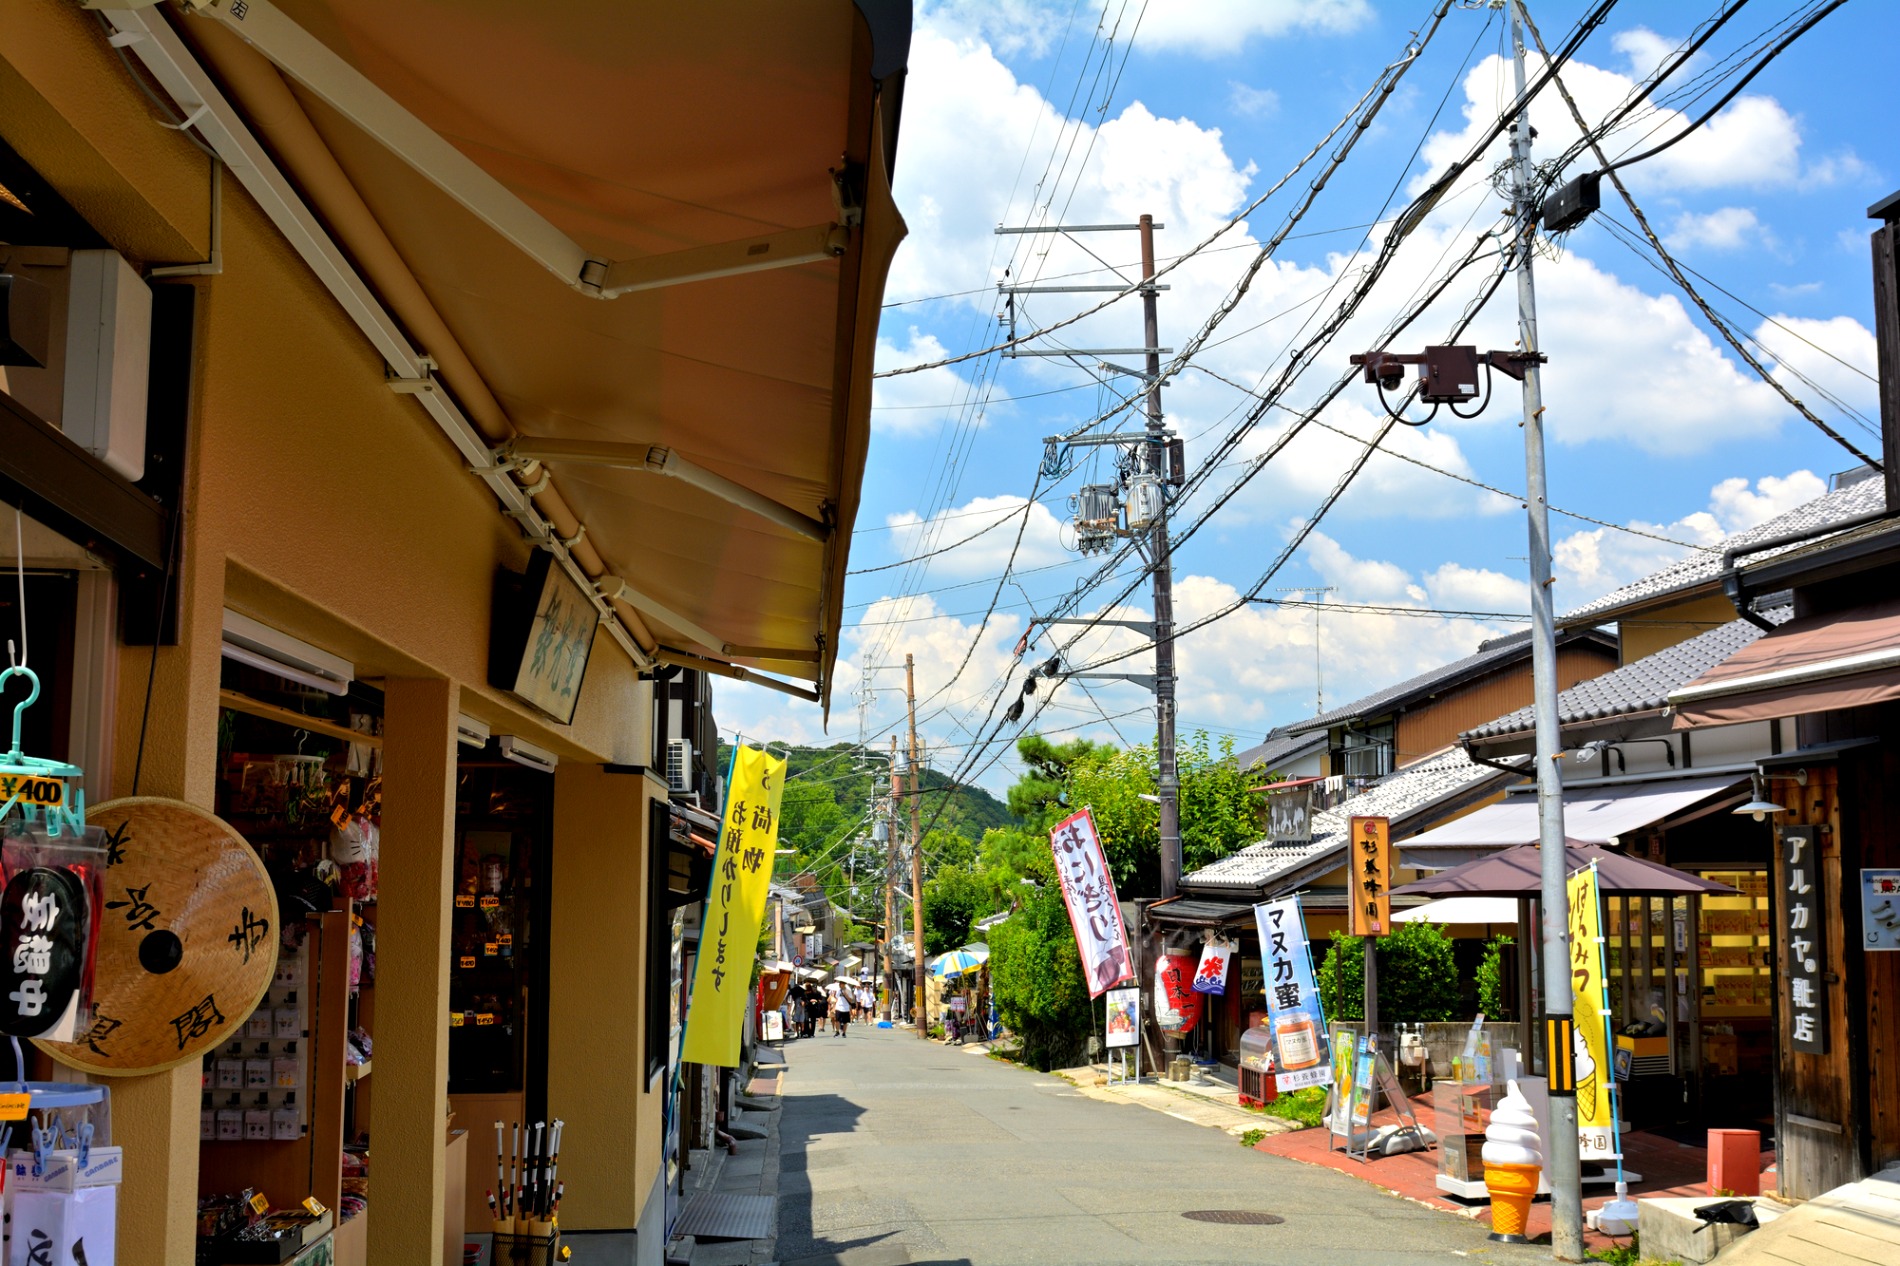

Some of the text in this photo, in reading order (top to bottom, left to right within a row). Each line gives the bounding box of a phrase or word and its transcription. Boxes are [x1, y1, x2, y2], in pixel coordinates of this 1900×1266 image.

[2, 777, 61, 803] ¥400
[1574, 880, 1590, 992] はちみつ
[1200, 956, 1224, 978] 氷
[1268, 908, 1302, 1011] マヌカ蜜
[1167, 968, 1195, 1009] 日本一
